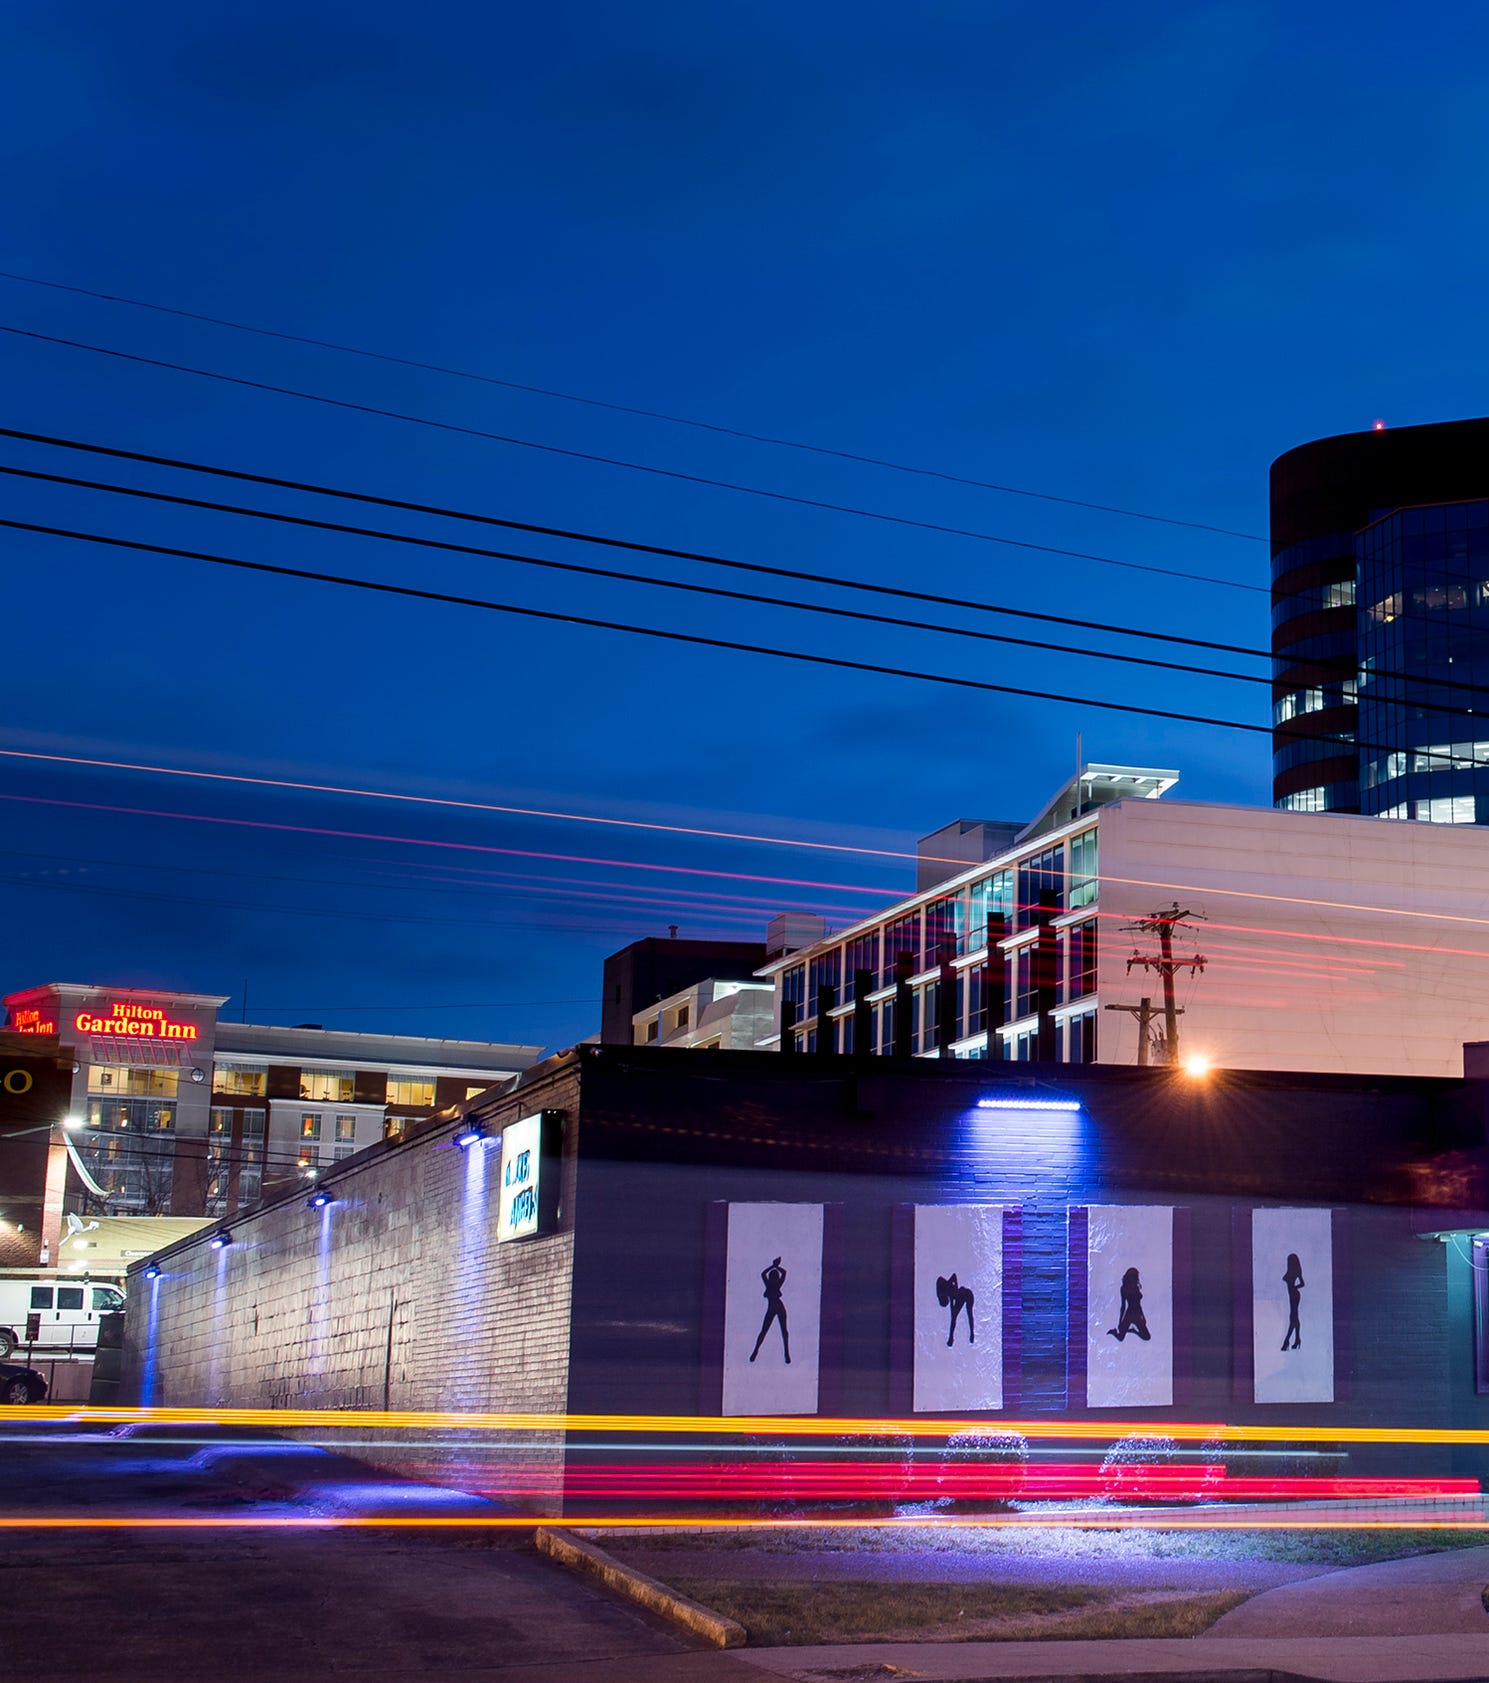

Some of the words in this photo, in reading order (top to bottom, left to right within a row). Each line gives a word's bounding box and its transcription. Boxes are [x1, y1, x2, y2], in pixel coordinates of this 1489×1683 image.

[113, 1004, 163, 1019] Hilton
[76, 1014, 154, 1035] Garden
[159, 1019, 197, 1039] Inn
